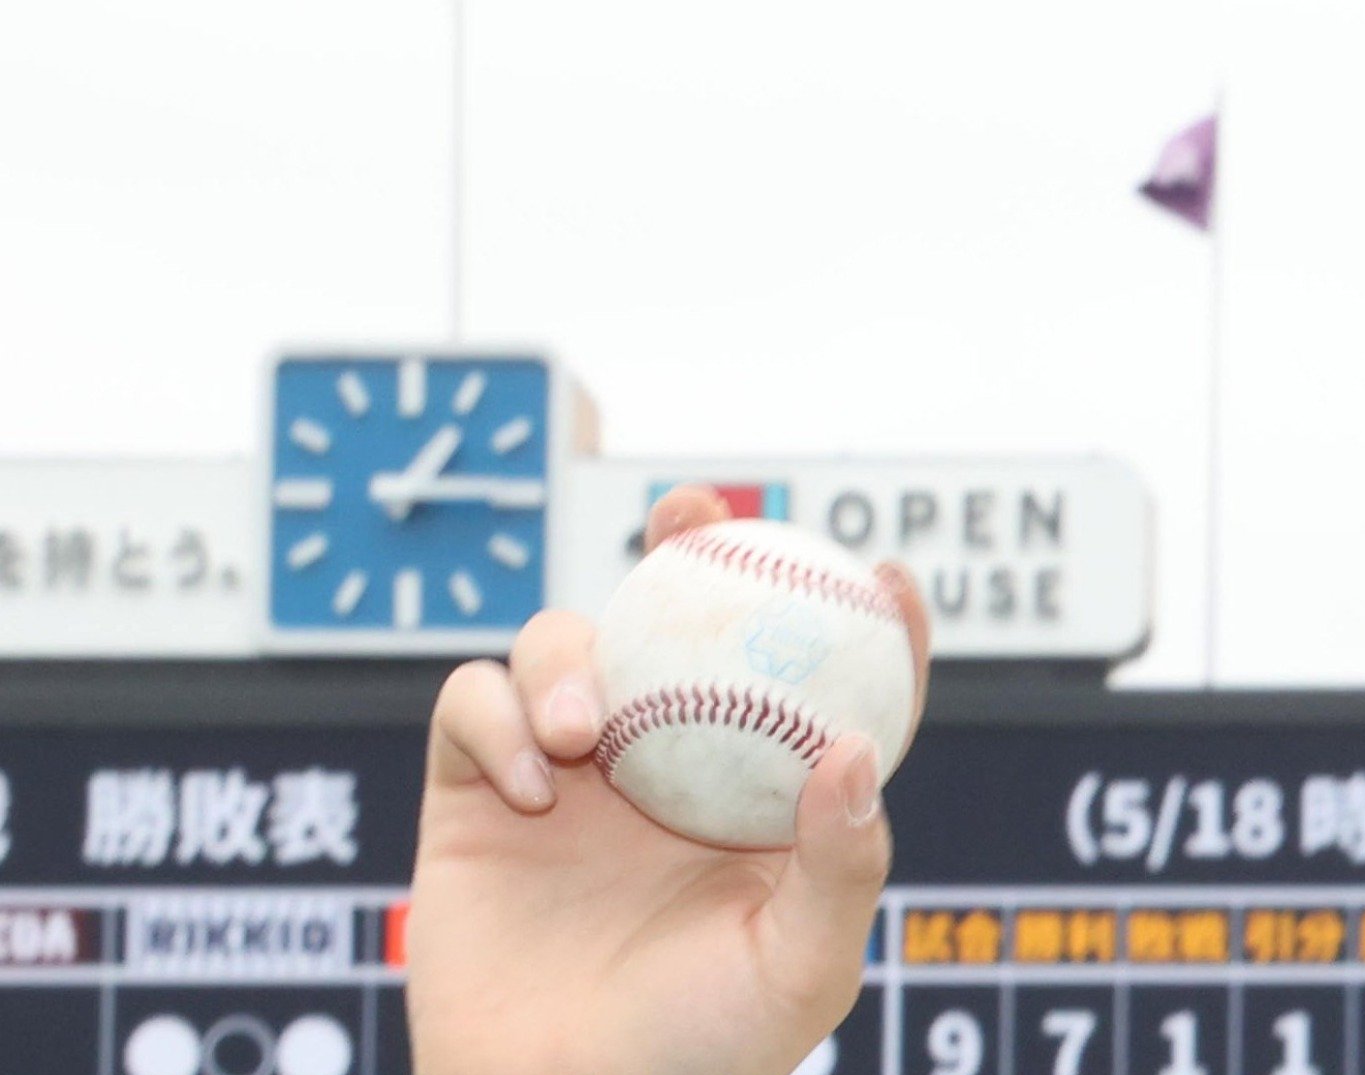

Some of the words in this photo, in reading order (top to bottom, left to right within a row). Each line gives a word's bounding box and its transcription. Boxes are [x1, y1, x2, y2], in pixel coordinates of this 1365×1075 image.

[827, 488, 1064, 550] OPEN
[932, 567, 1062, 624] USE
[83, 767, 358, 866] 勝敗表
[146, 917, 334, 955] RIKKIO
